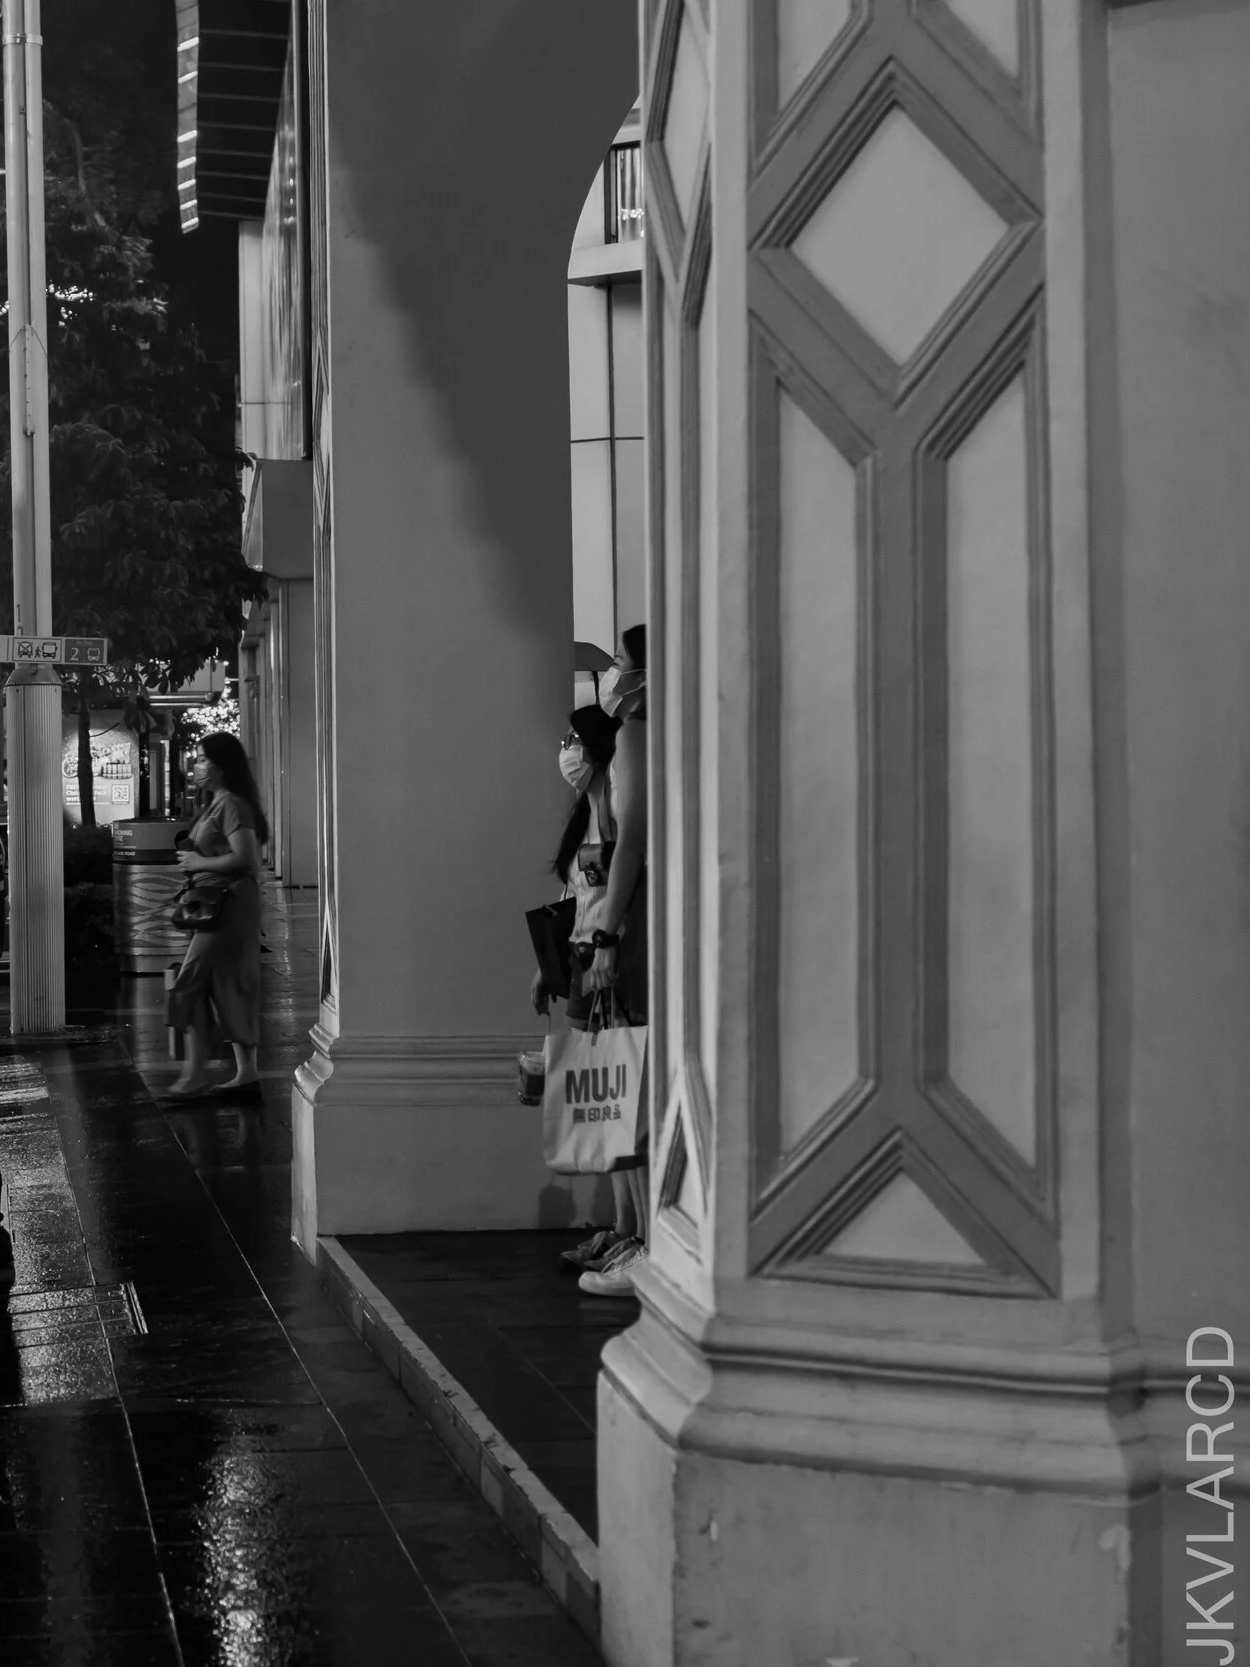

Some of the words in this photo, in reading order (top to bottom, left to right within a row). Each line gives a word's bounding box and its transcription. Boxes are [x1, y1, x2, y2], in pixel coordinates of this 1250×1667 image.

[70, 647, 79, 661] 2
[565, 1063, 627, 1104] MUJI
[572, 1103, 622, 1125] 無印良品
